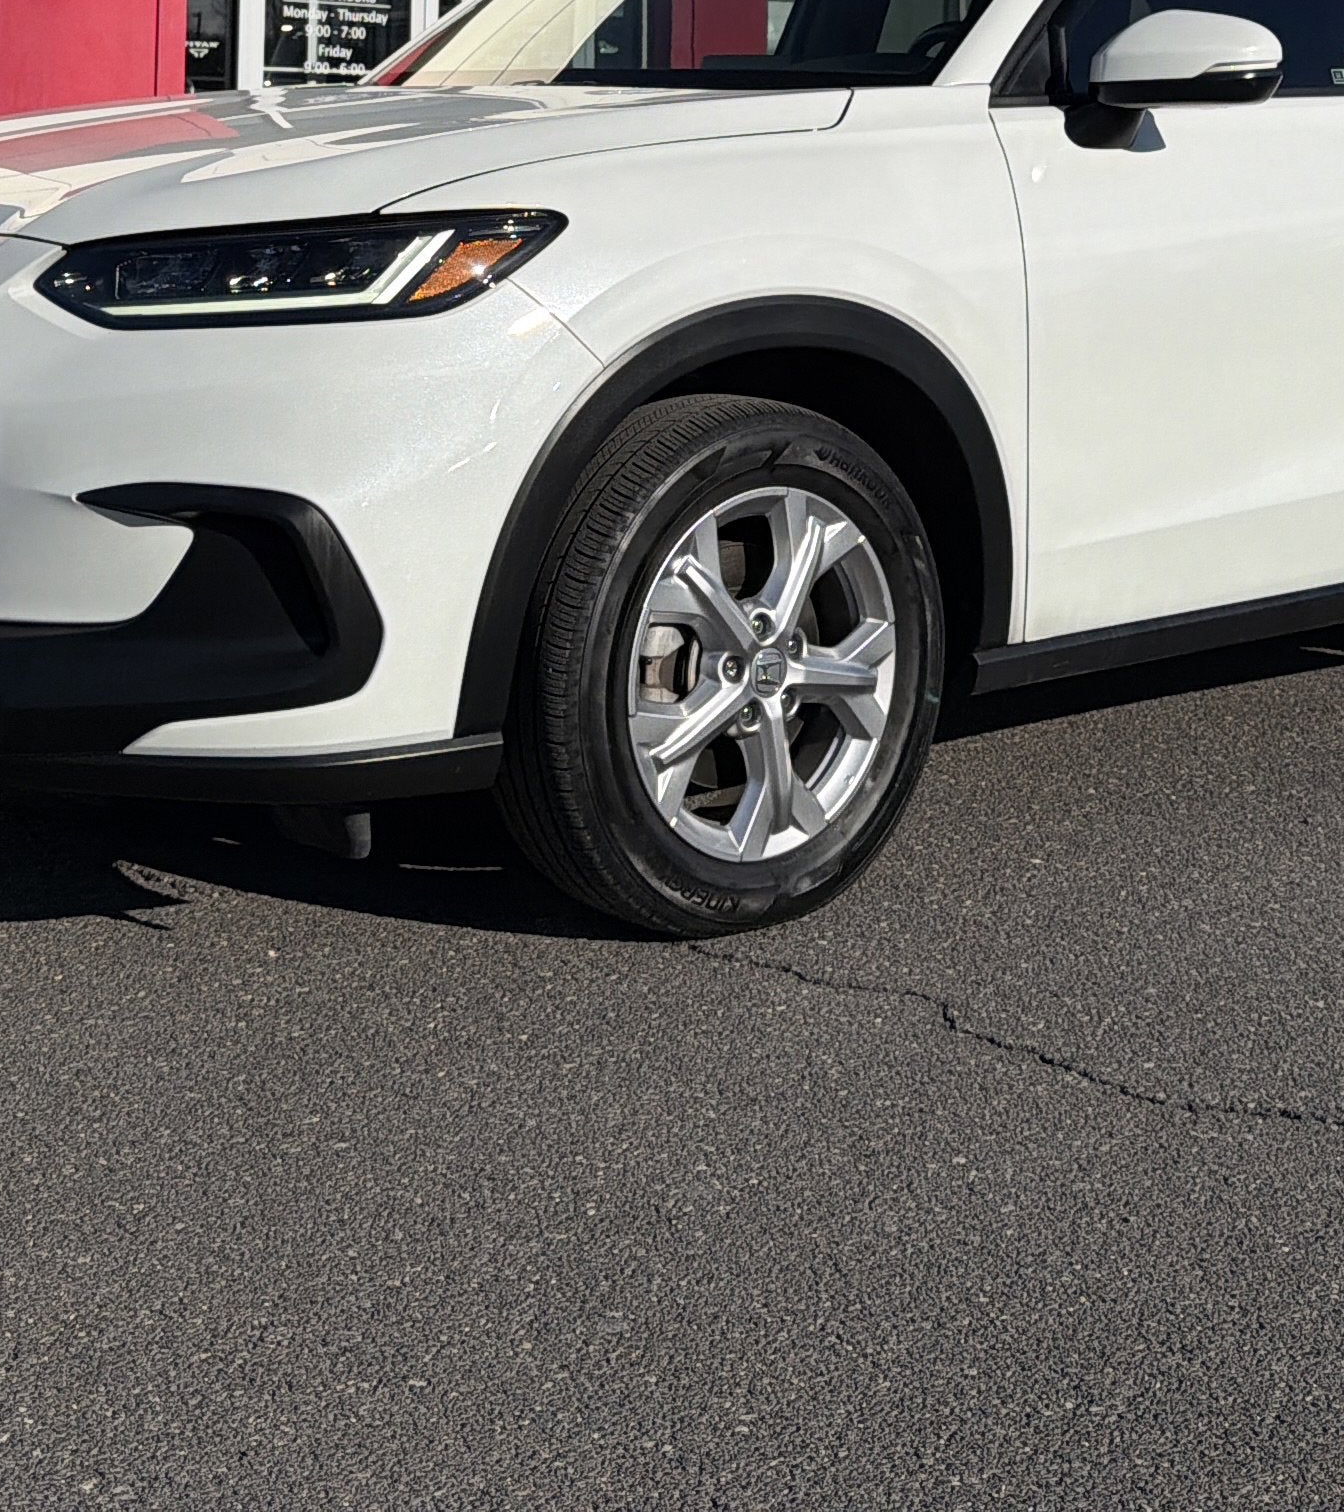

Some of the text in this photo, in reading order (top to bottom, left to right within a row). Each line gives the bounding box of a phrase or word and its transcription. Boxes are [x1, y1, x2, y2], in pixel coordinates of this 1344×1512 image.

[283, 5, 328, 21] Monday
[338, 8, 388, 25] Thursday
[341, 26, 366, 39] 7:00
[318, 44, 352, 60] Friday
